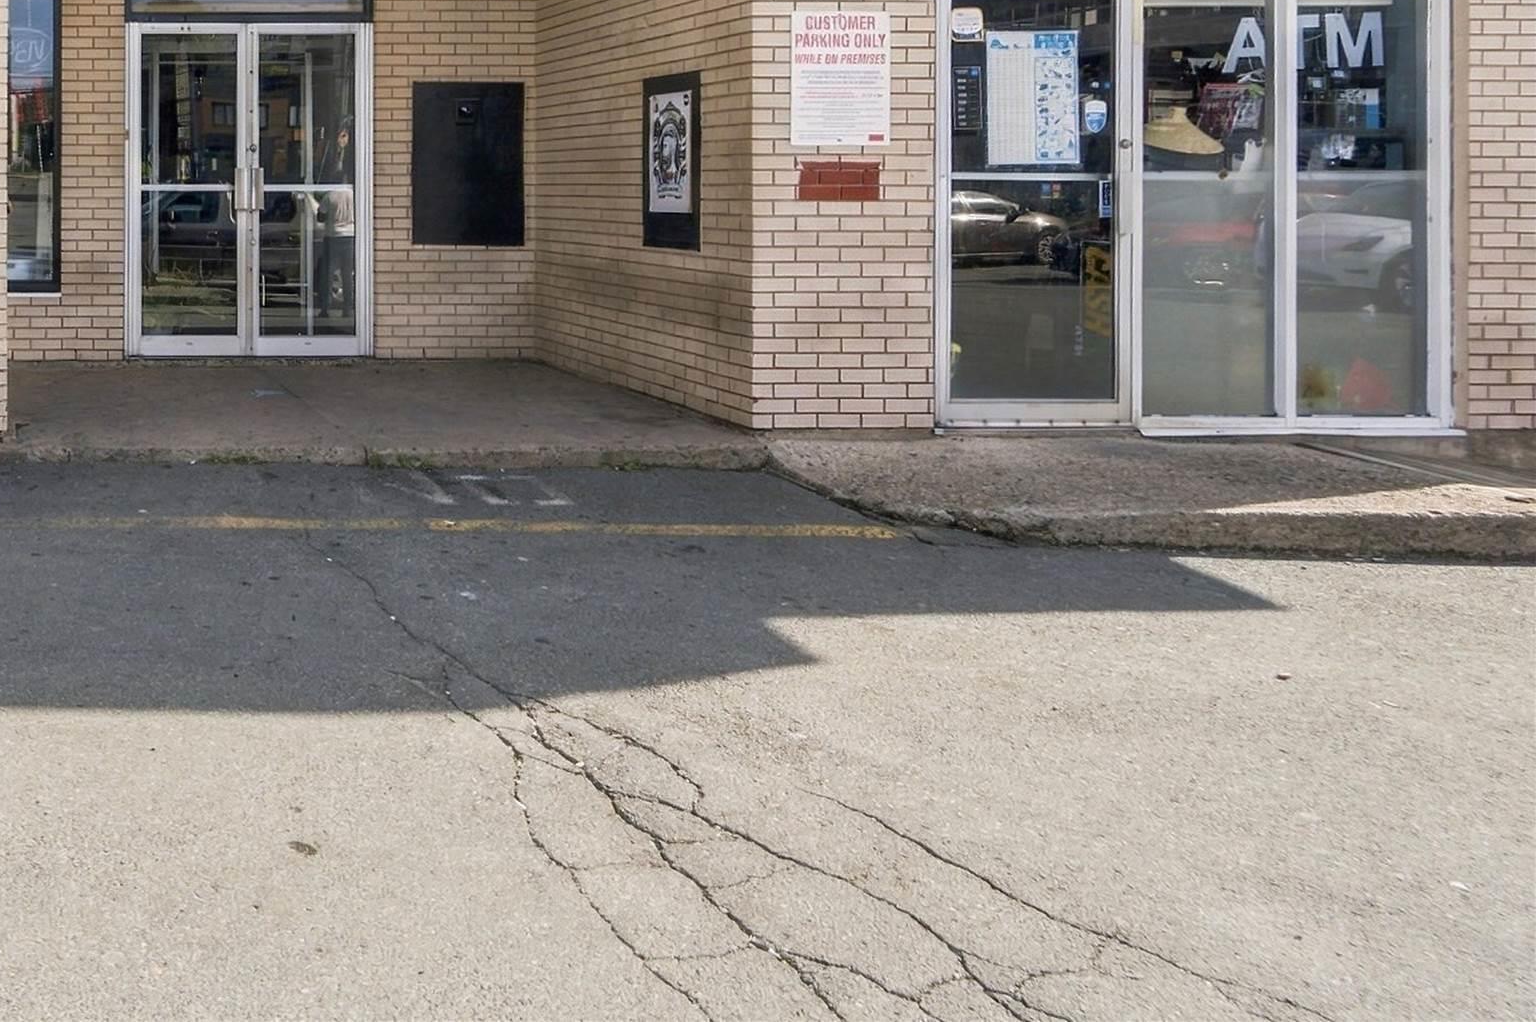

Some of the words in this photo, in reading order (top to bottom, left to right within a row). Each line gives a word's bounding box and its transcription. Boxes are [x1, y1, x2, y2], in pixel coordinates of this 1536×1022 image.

[805, 15, 876, 30] CUSTOMER
[795, 33, 850, 48] PARKING
[854, 33, 886, 48] ONLY
[1221, 11, 1385, 74] ATM
[795, 54, 823, 64] WHILE
[825, 54, 839, 64] ON
[840, 54, 887, 64] PREMISES
